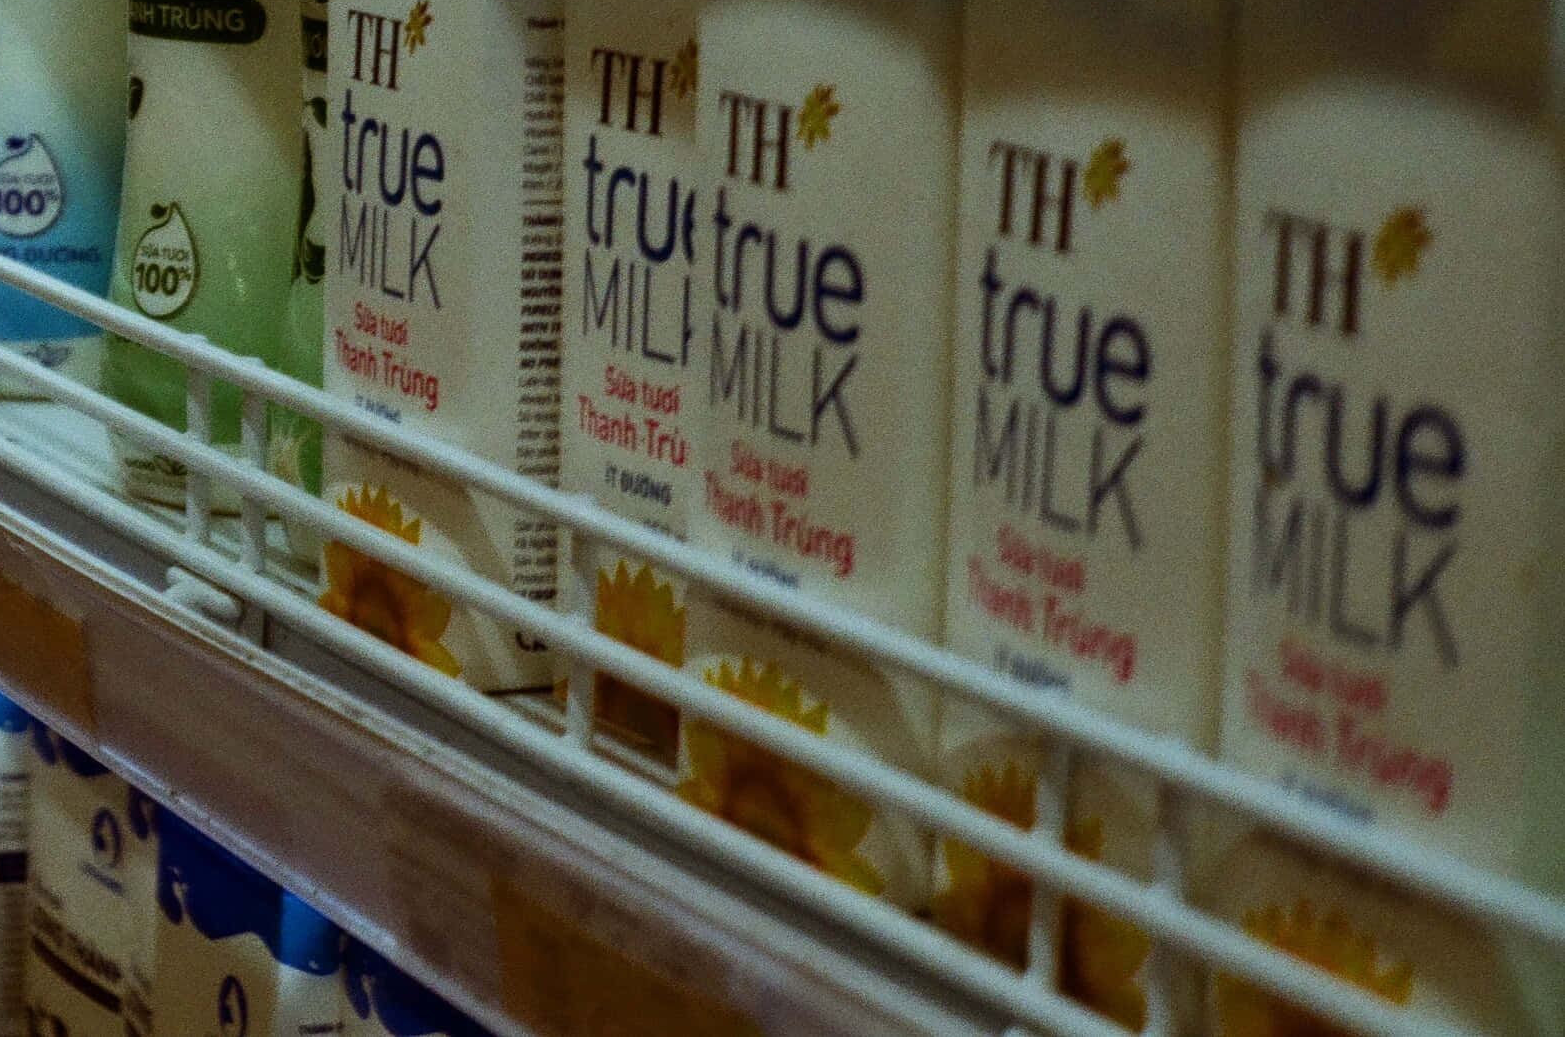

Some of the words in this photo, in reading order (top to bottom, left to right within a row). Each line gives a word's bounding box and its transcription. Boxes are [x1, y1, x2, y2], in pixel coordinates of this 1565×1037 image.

[347, 8, 402, 91] TH
[591, 46, 671, 137] TH
[341, 88, 446, 216] true
[718, 88, 794, 193] TH
[987, 139, 1080, 255] TH
[135, 262, 192, 297] 100%
[339, 194, 442, 310] MILK
[711, 185, 865, 344] true
[1264, 208, 1366, 337] TH
[334, 327, 379, 382] Thanh
[709, 310, 861, 459] MILK
[979, 244, 1154, 427] true
[577, 393, 637, 452] Thanh
[645, 417, 687, 467] Trù
[973, 384, 1145, 551] MILK
[1255, 326, 1466, 531] true
[1251, 467, 1460, 670] MILK
